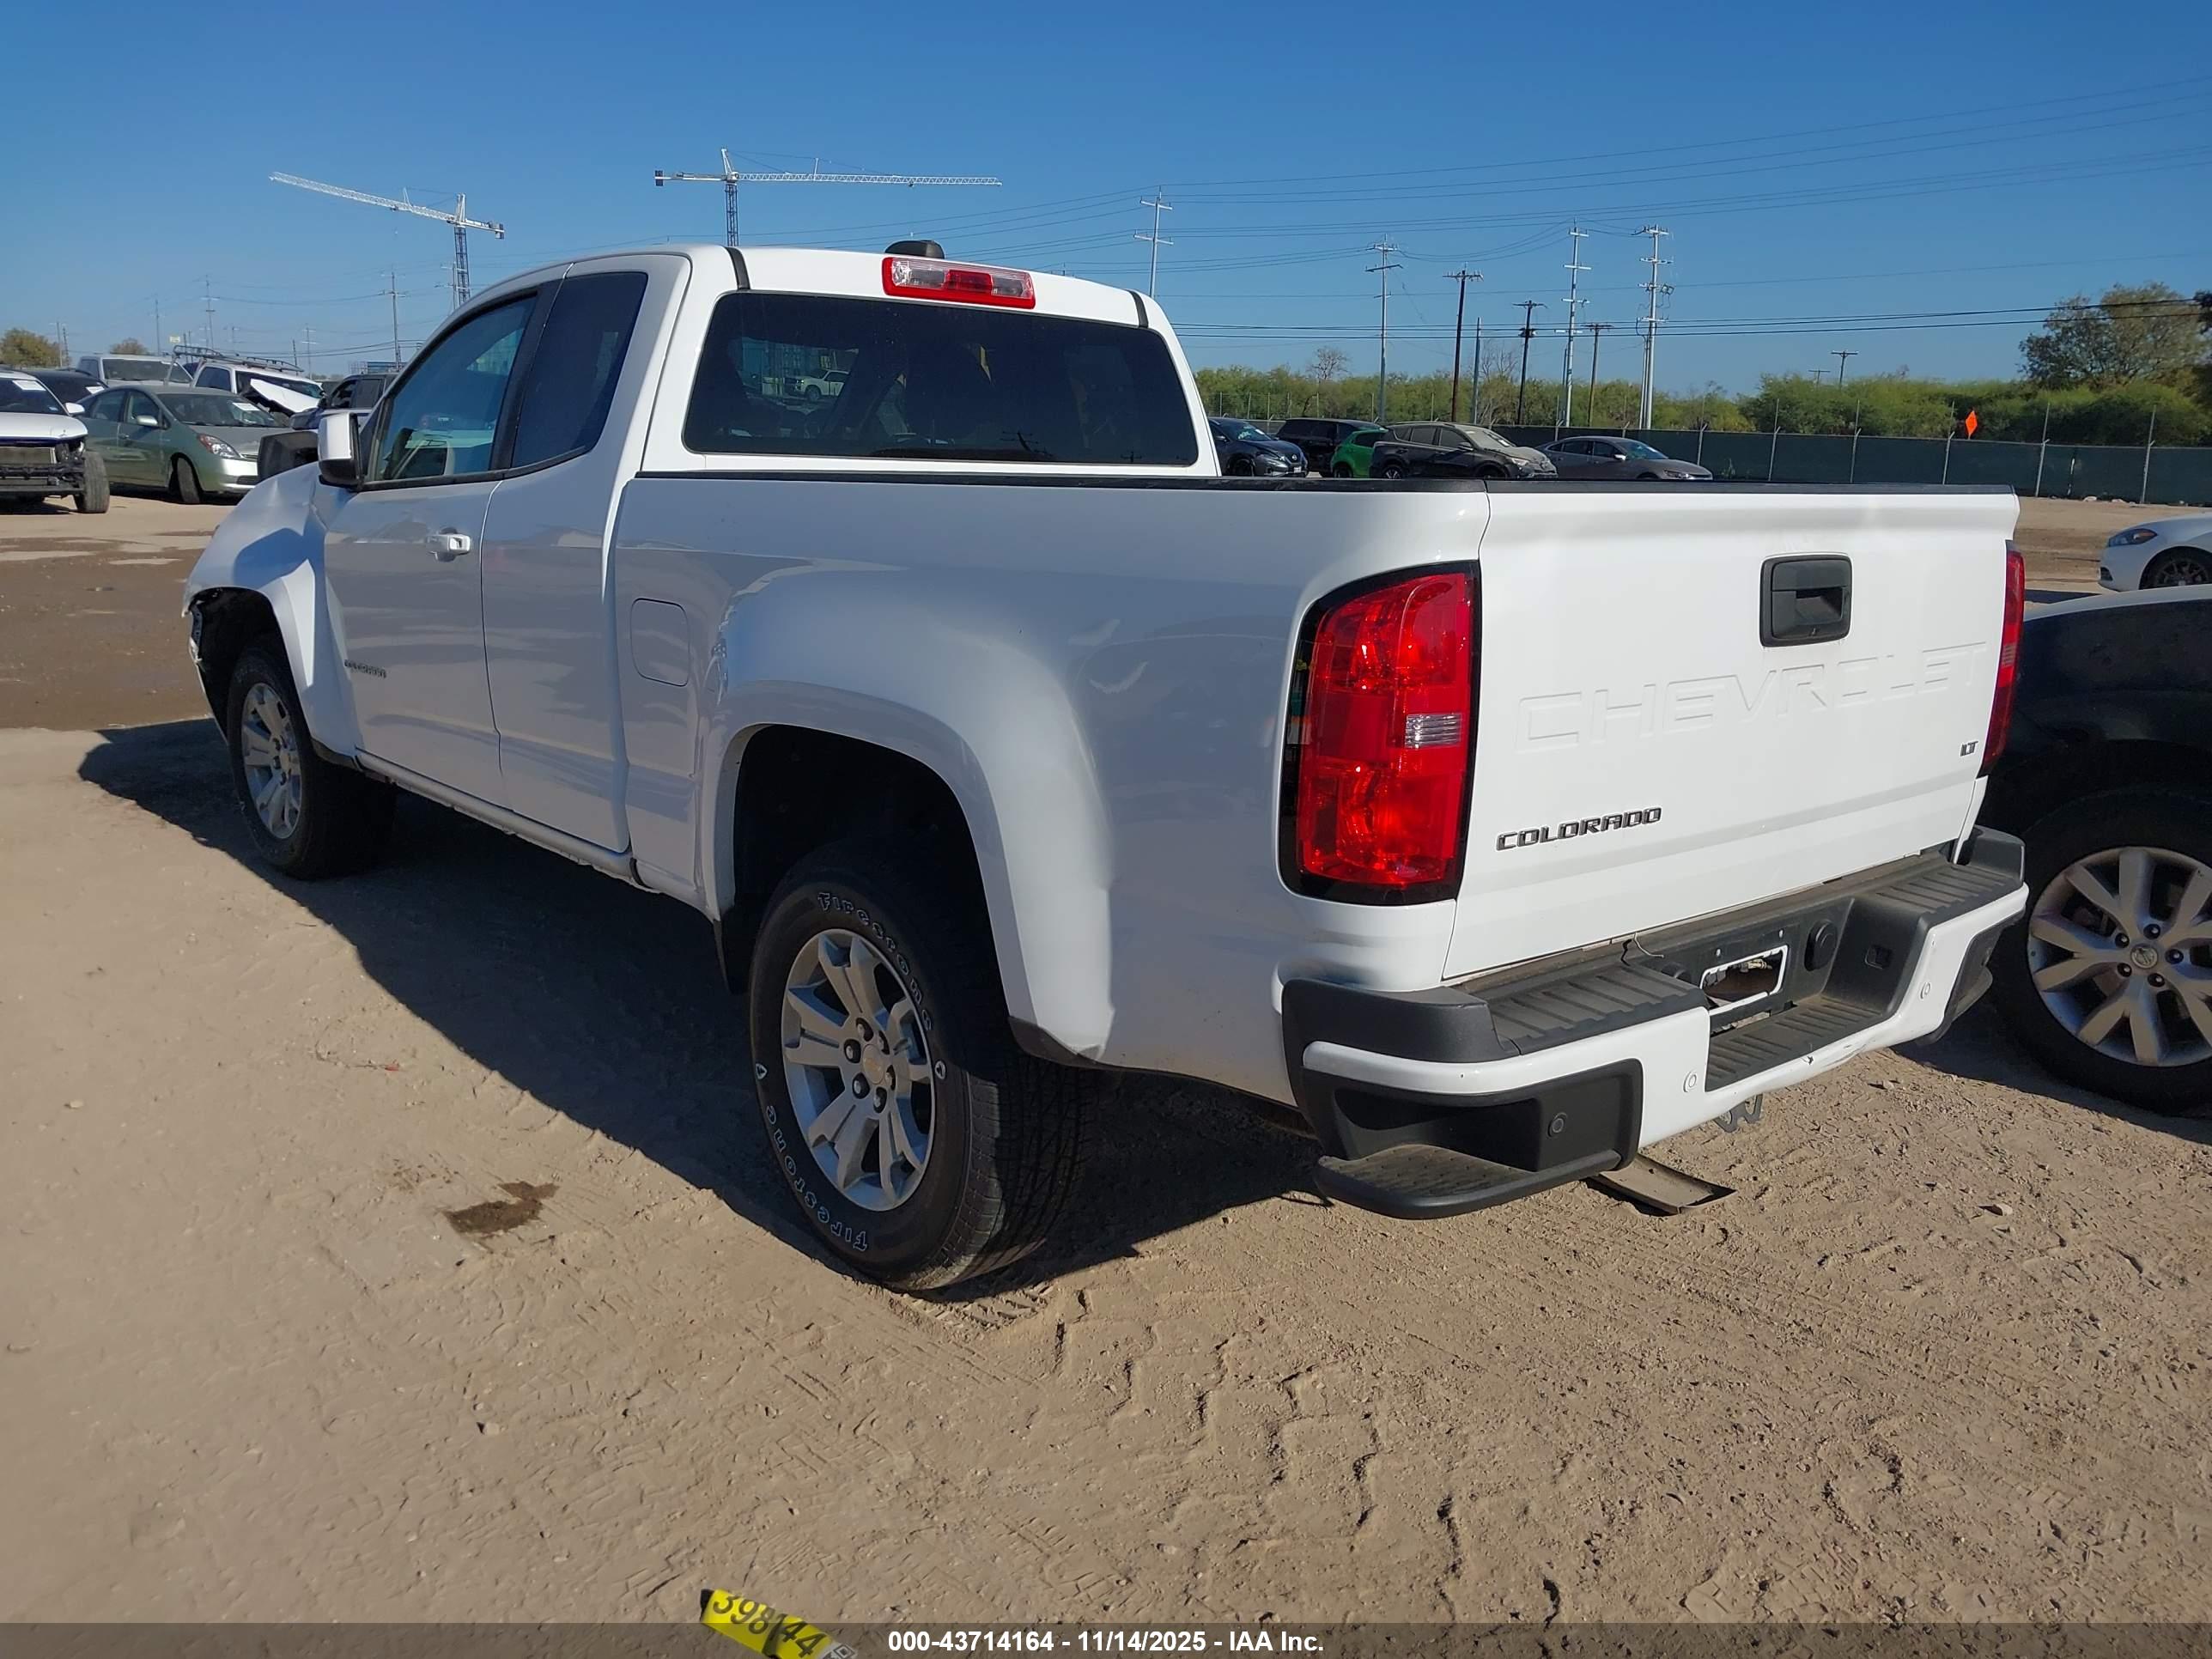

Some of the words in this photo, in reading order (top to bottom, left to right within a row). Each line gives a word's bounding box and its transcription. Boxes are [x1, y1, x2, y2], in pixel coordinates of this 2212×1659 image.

[1516, 641, 1988, 754] CHEVROLET
[1960, 740, 1979, 757] LT
[1496, 807, 1662, 851] COLORADO
